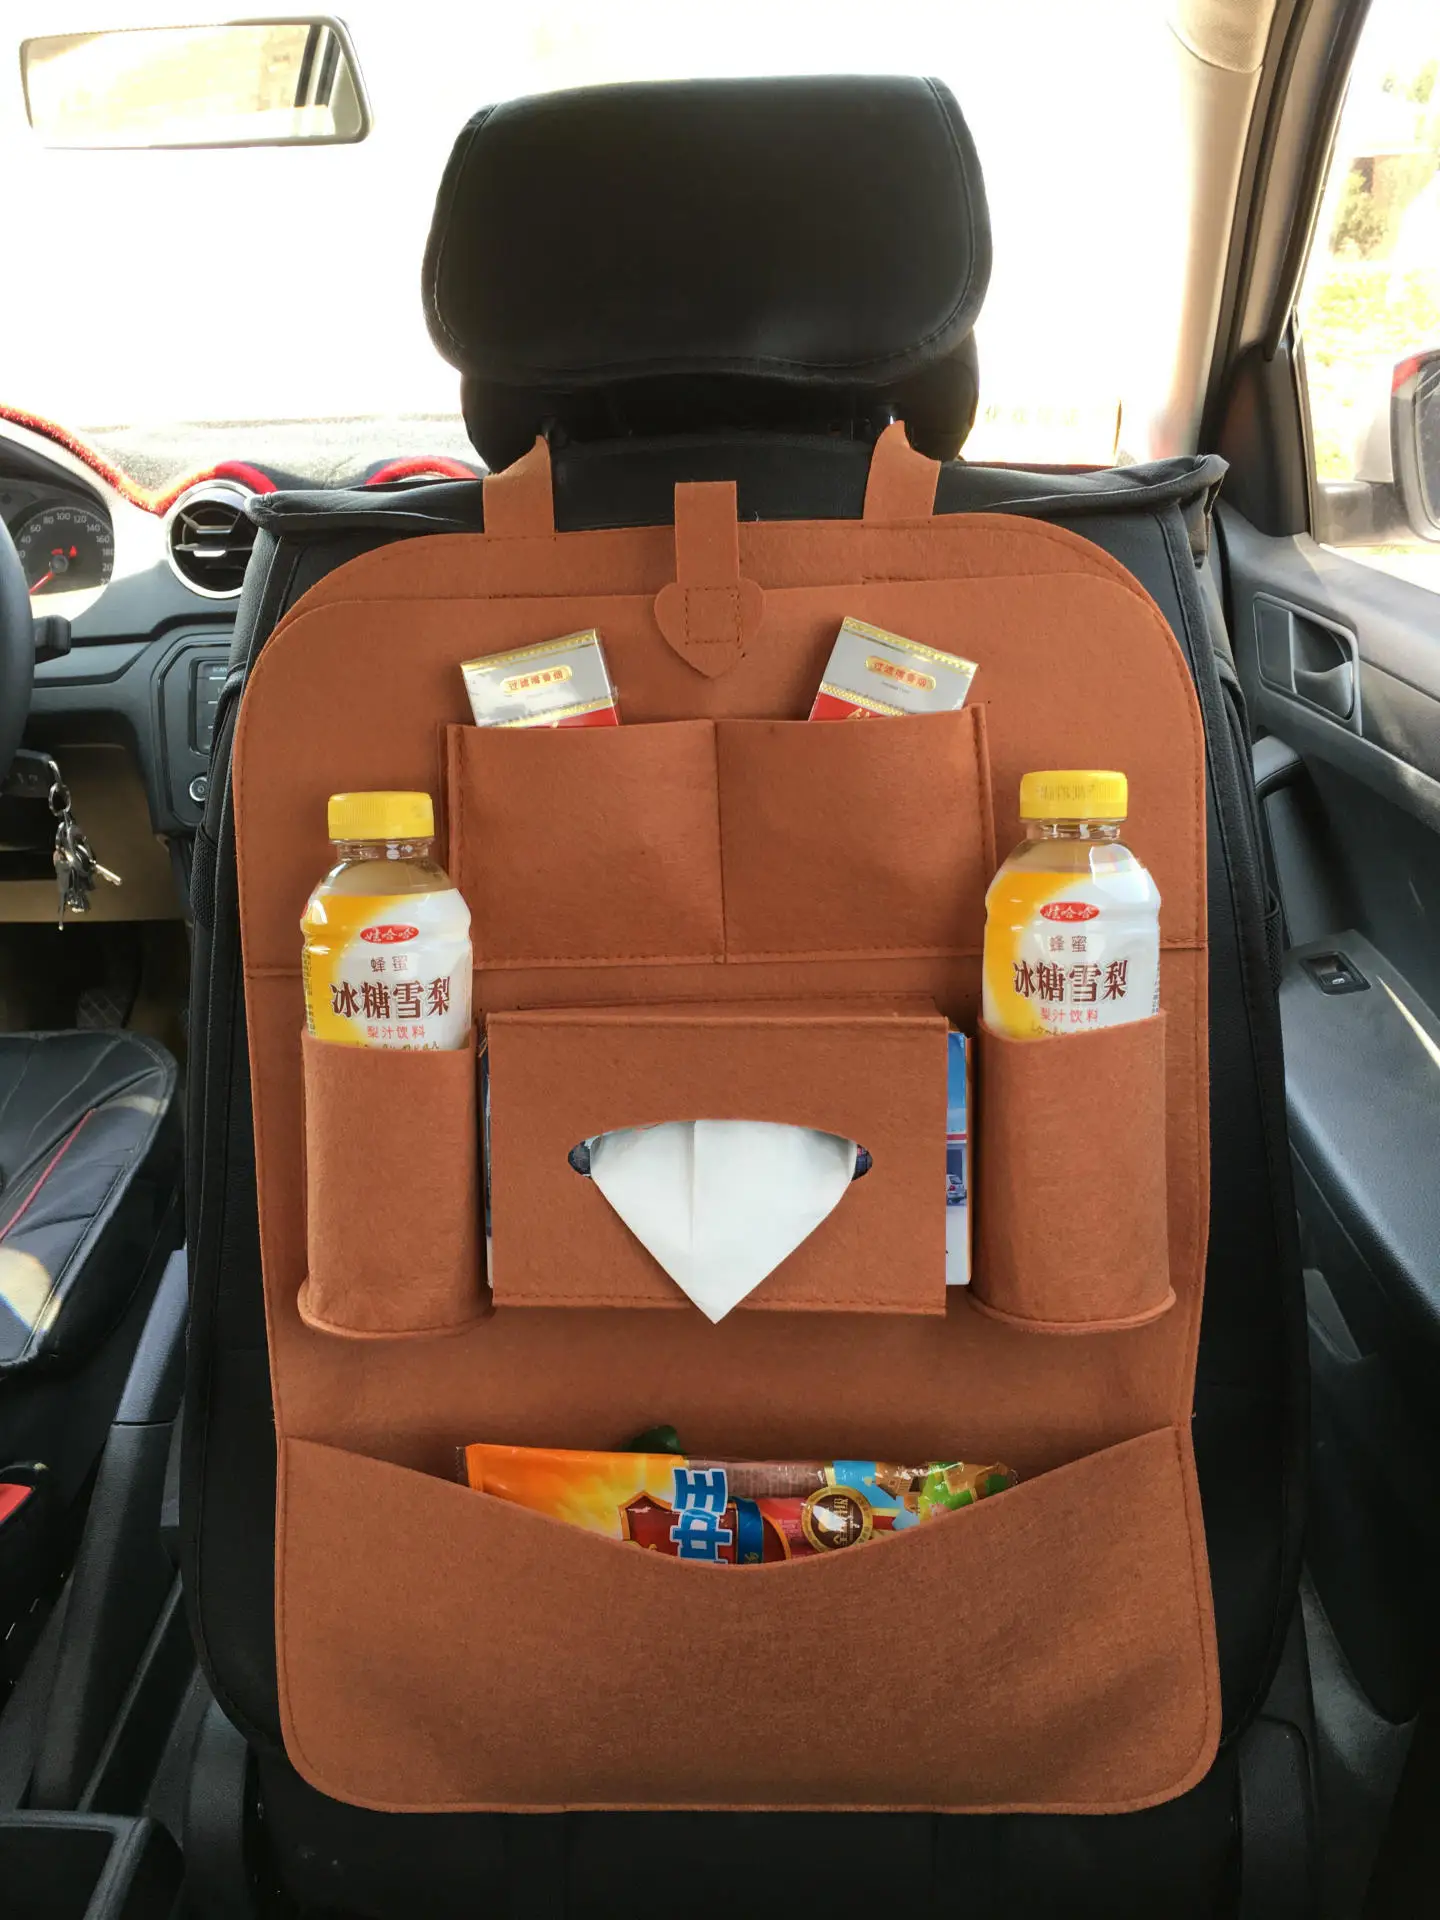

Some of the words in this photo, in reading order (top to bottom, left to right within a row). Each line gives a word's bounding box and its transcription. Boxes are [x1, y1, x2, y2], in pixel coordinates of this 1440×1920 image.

[56, 512, 71, 520] 100
[73, 515, 87, 524] 120
[30, 524, 41, 532] 60
[86, 524, 101, 532] 140
[21, 535, 31, 544] 40
[96, 535, 110, 543] 160
[1043, 903, 1095, 920] 娃哈哈
[364, 927, 415, 943] 娃哈哈
[1049, 935, 1087, 953] 蜂蜜
[370, 955, 408, 972] 蜂蜜
[1012, 959, 1129, 1003] 冰糖雪梨
[330, 976, 451, 1019] 冰糖雪梨
[1039, 1007, 1099, 1023] 梨汁饮料
[366, 1024, 426, 1040] 梨汁饮料
[670, 1467, 733, 1564] 中王
